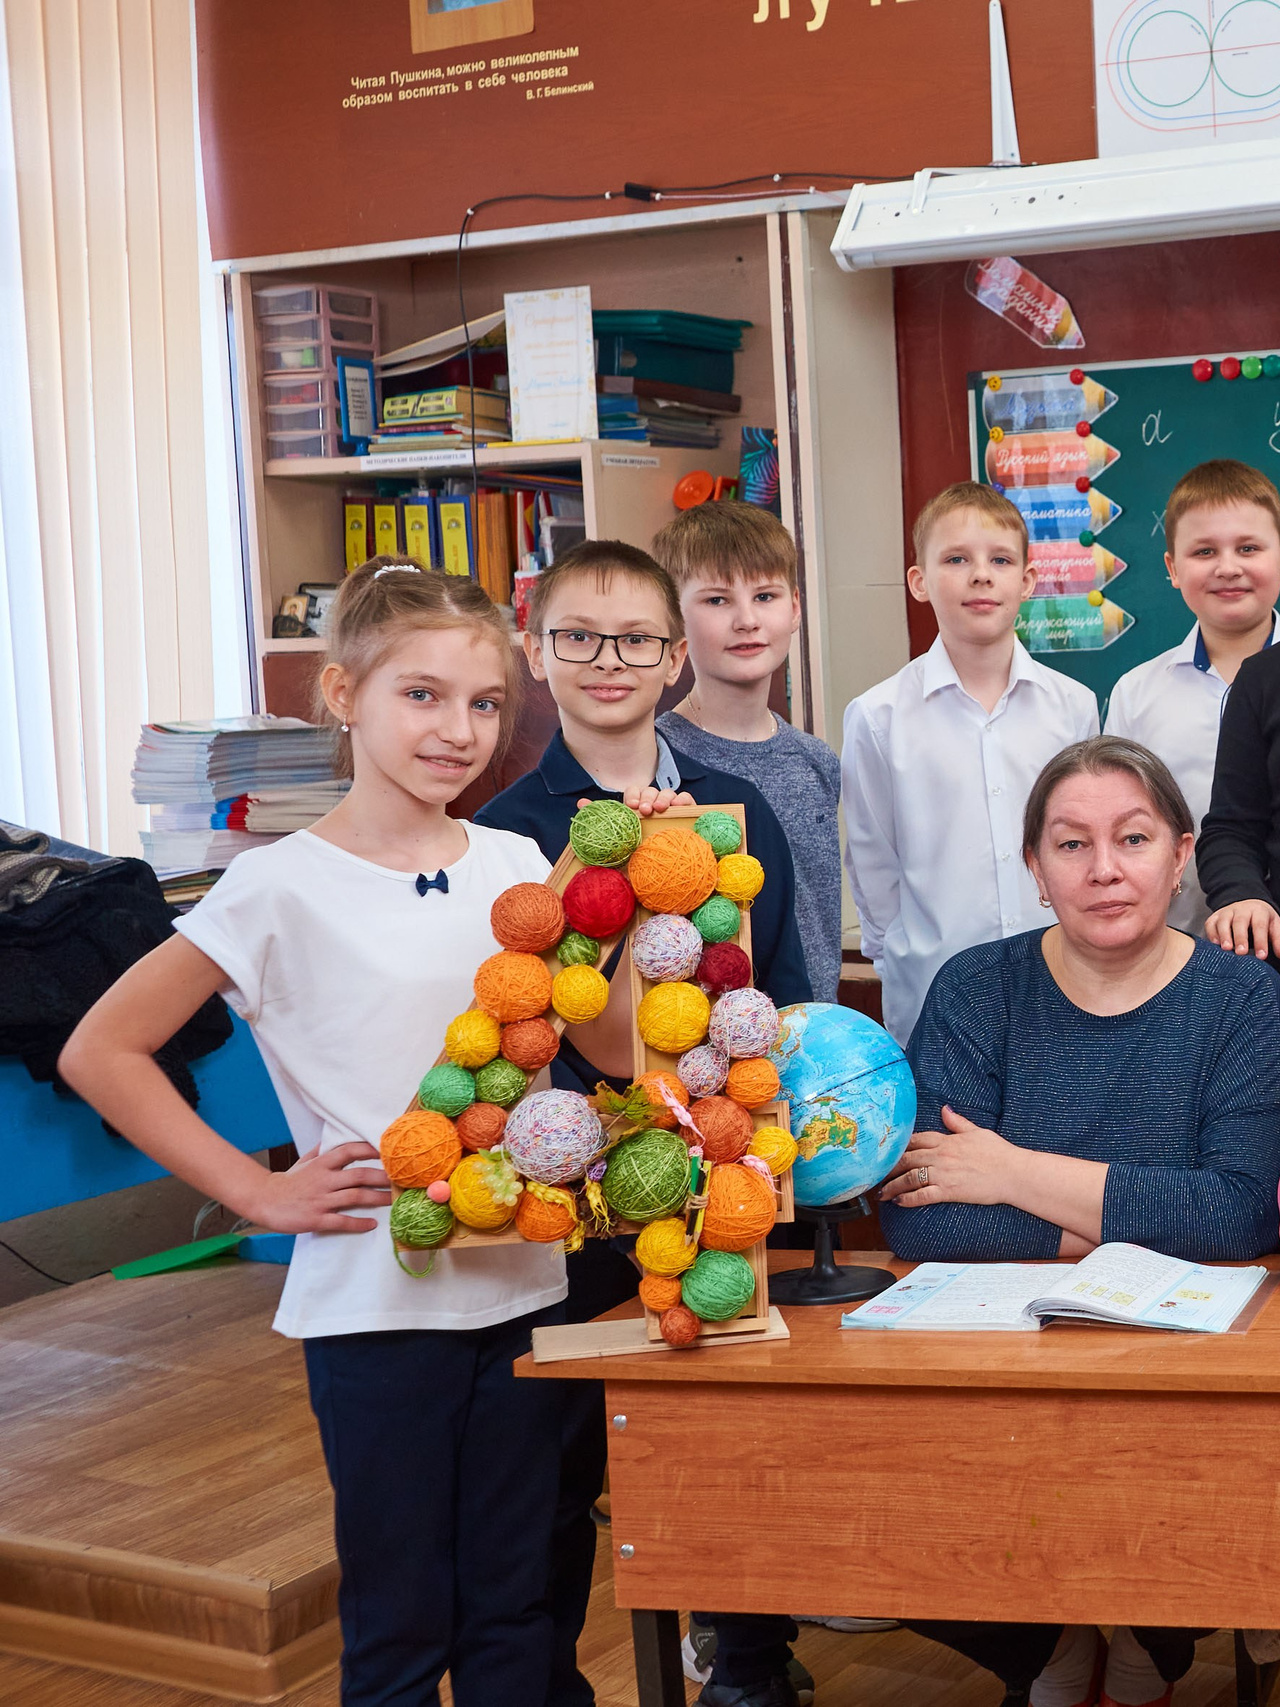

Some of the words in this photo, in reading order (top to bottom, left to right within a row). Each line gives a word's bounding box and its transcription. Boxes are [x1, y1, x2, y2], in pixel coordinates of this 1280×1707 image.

[350, 75, 386, 90] Читая
[390, 67, 445, 86] Пушкина,
[446, 61, 486, 77] можно
[491, 46, 579, 70] великолепным
[342, 91, 393, 109] образом
[398, 83, 459, 102] воспитать
[465, 80, 473, 91] в
[478, 74, 506, 90] себе
[511, 65, 569, 84] человека
[544, 80, 595, 98] Белинский
[995, 448, 1049, 474] Русский
